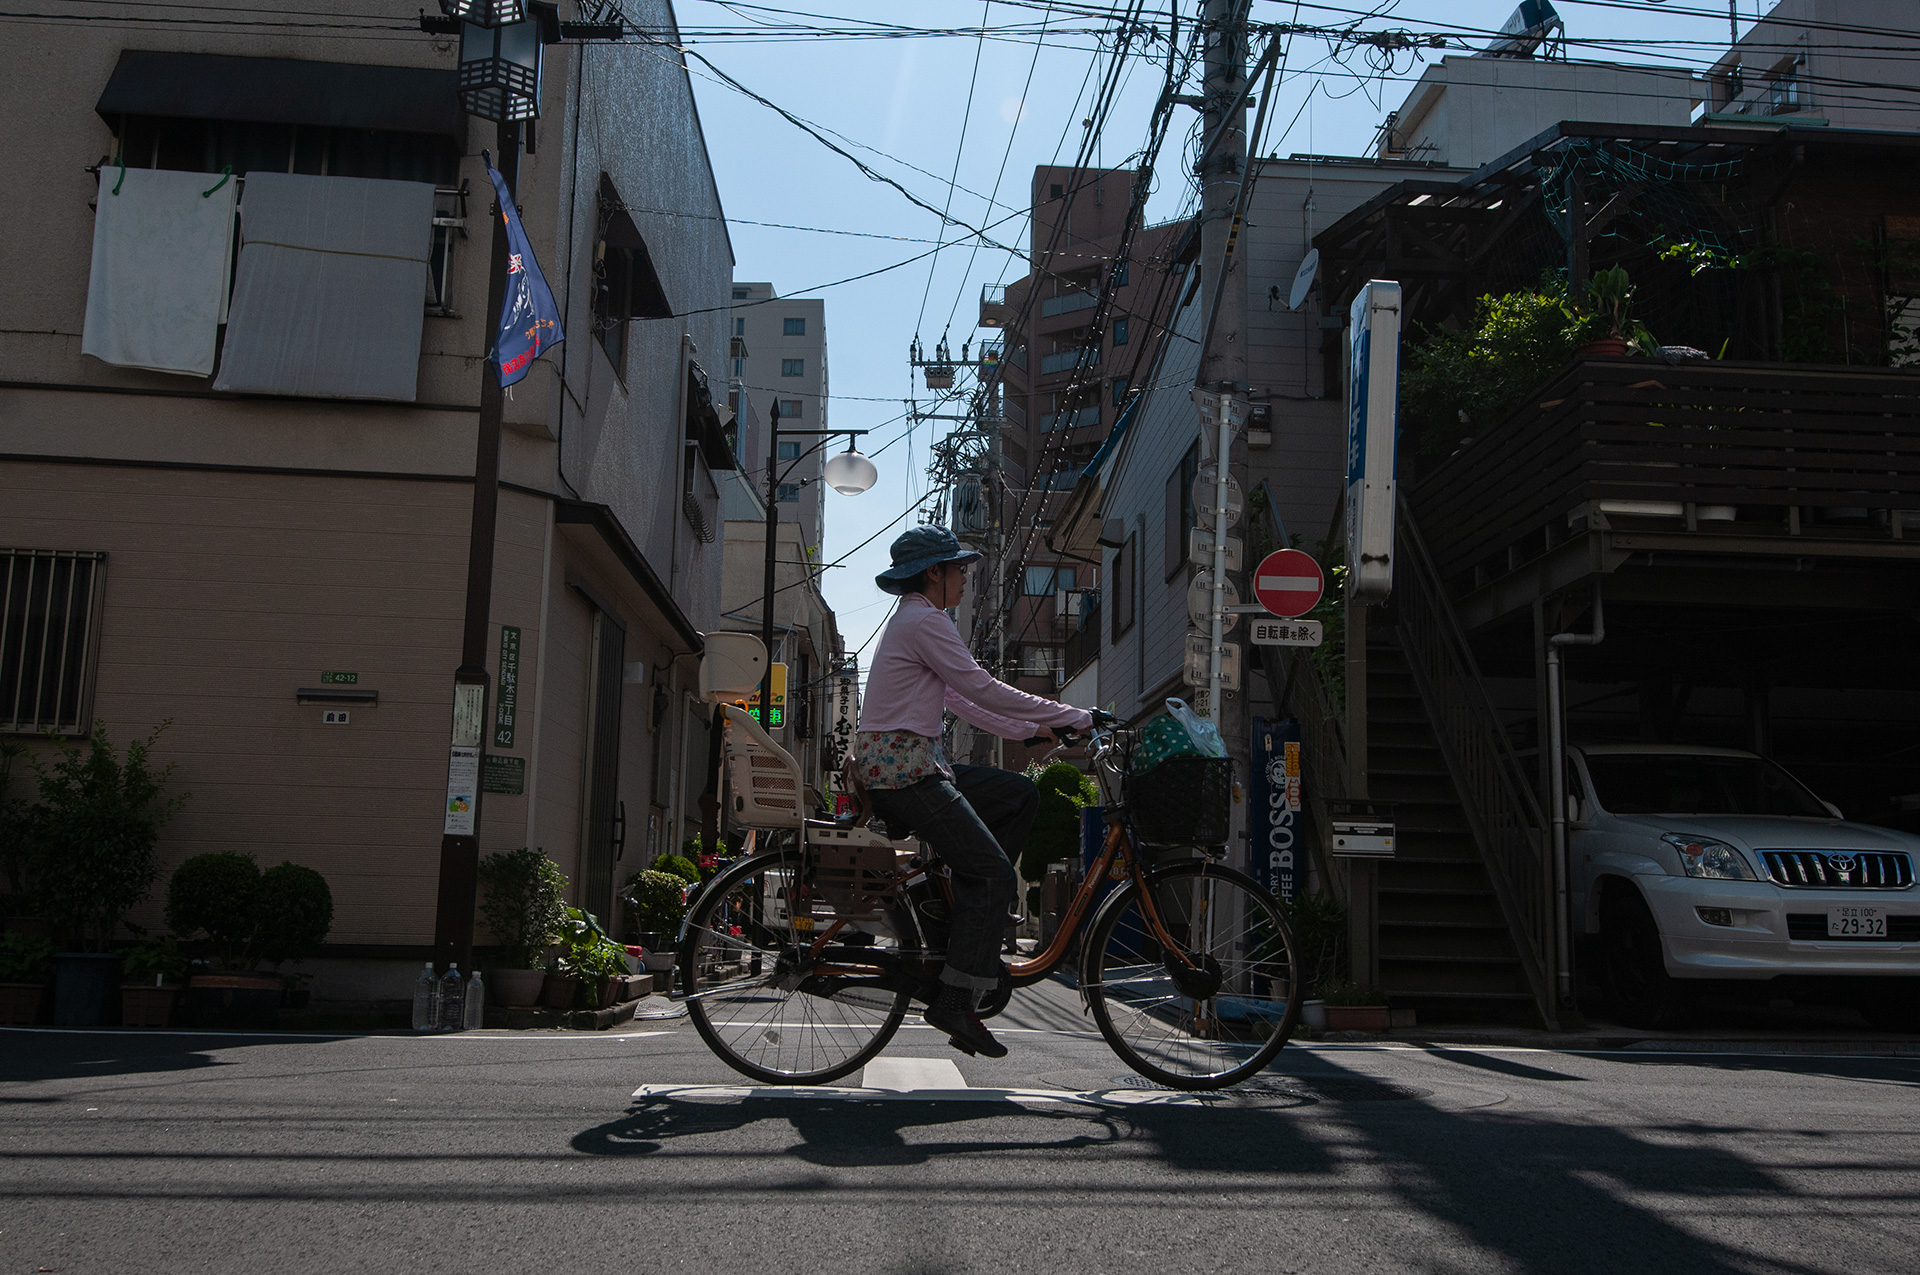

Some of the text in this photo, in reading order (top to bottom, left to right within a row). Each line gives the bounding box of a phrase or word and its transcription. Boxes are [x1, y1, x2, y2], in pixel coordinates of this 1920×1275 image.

[1257, 625, 1316, 642] 自転車を除く
[335, 674, 356, 682] 42-12
[504, 631, 518, 726] 文京区千駄木三丁目
[497, 730, 512, 744] 42
[1285, 743, 1293, 776] DOWN
[1292, 743, 1300, 777] PRICE
[1269, 792, 1294, 870] BOSS
[1842, 908, 1874, 917] 足立 100
[1841, 918, 1884, 934] 29-32
